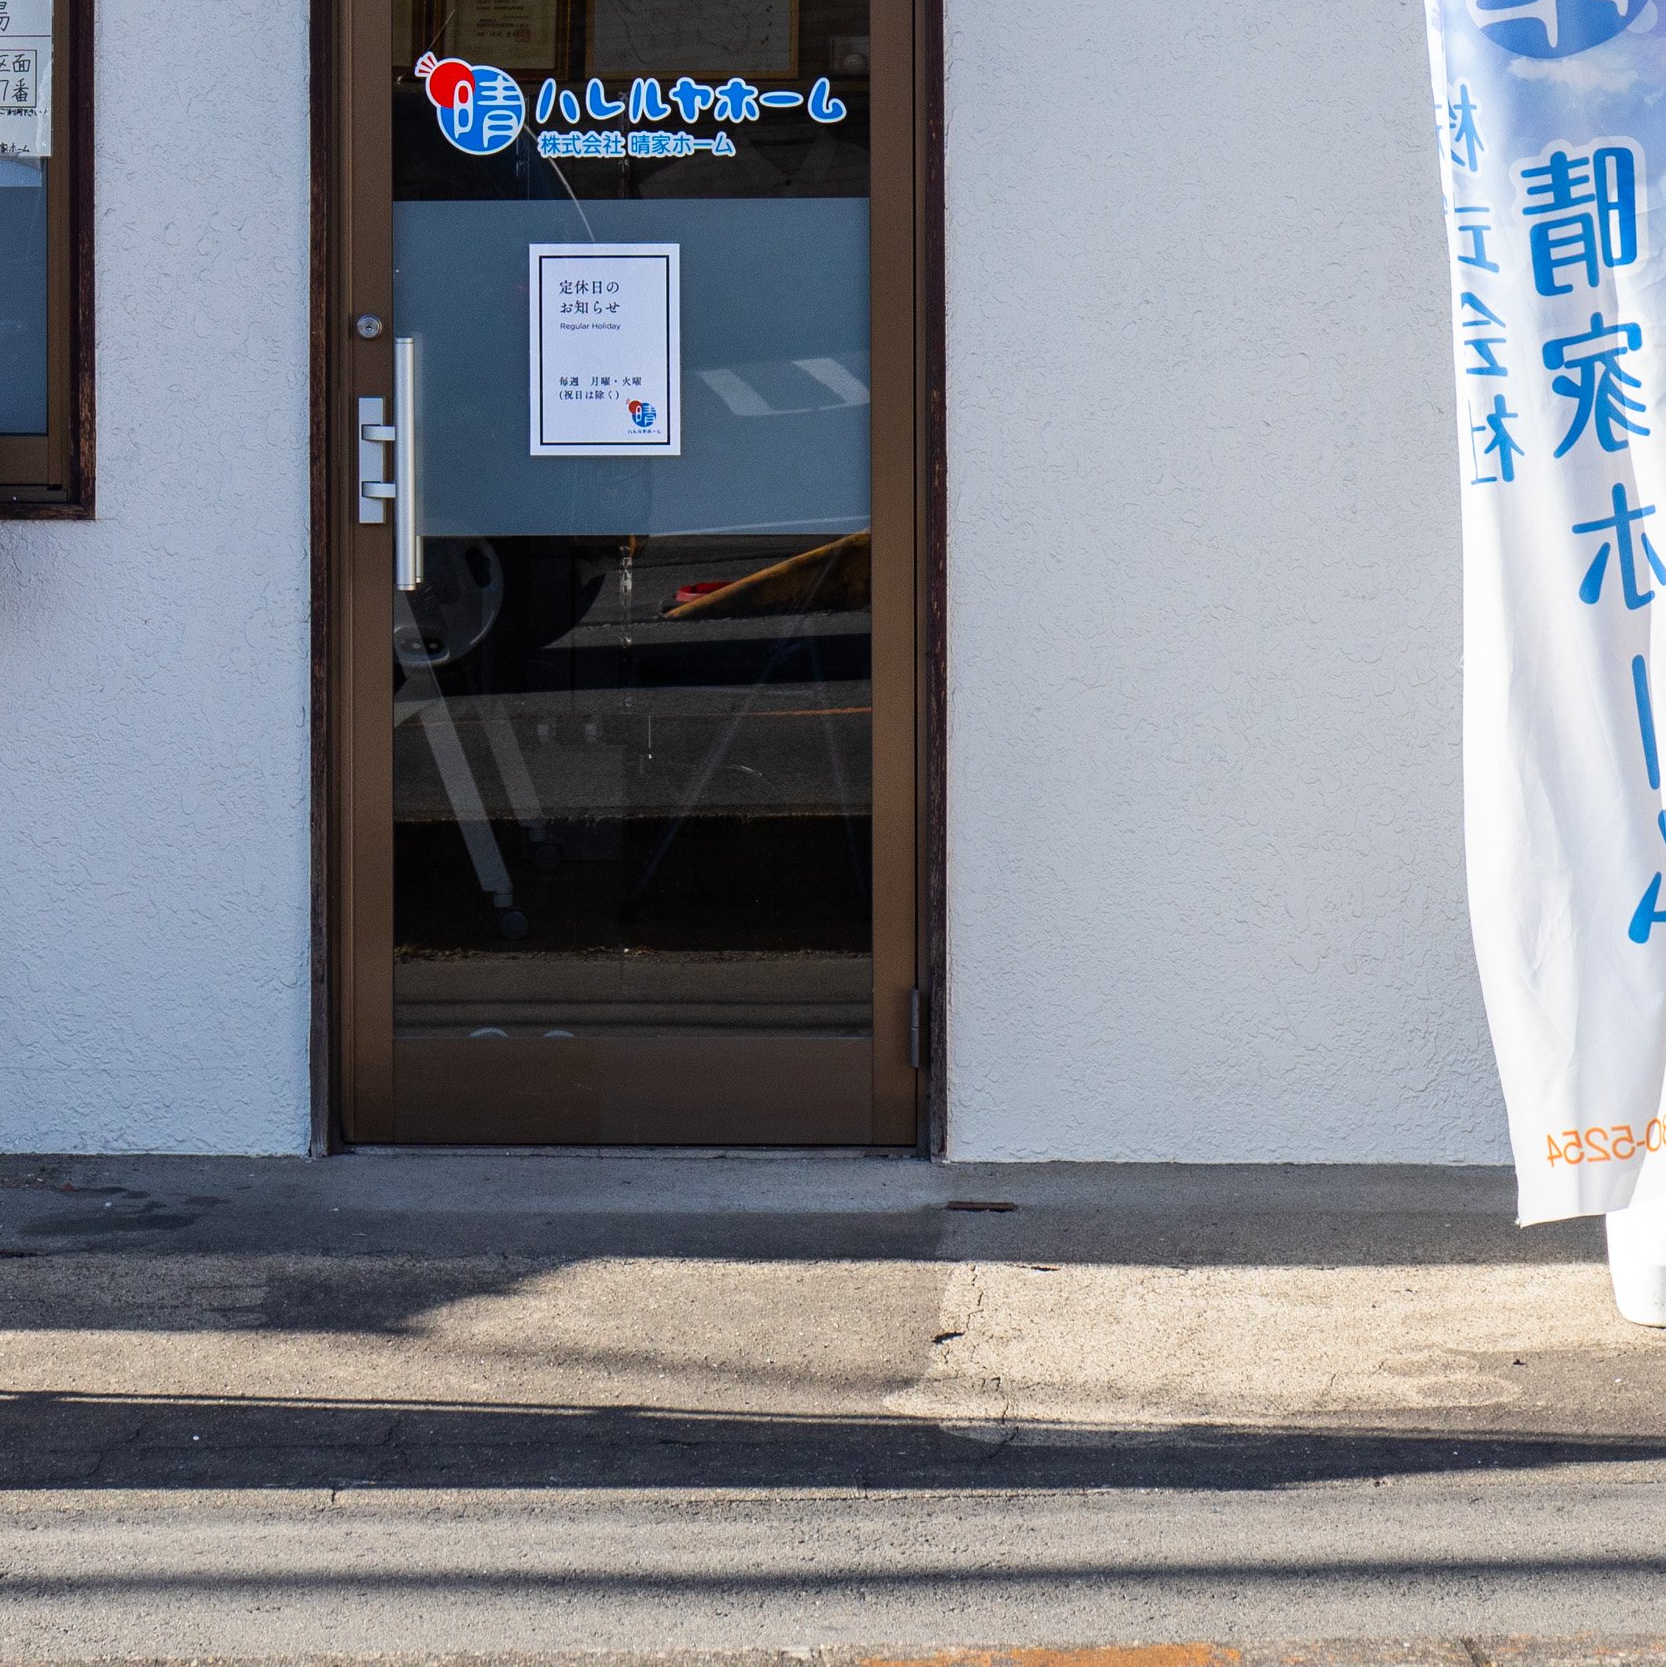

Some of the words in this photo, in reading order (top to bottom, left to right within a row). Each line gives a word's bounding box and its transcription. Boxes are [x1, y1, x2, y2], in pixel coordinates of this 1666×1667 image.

[536, 77, 848, 125] ハレルヤホーム
[452, 74, 523, 150] 晴
[540, 133, 624, 157] 株式会社
[630, 133, 736, 157] 晴家ホーム
[559, 279, 620, 295] 定休日の
[559, 300, 621, 315] お知らせ
[560, 322, 590, 331] Regular
[591, 322, 621, 331] Holiday
